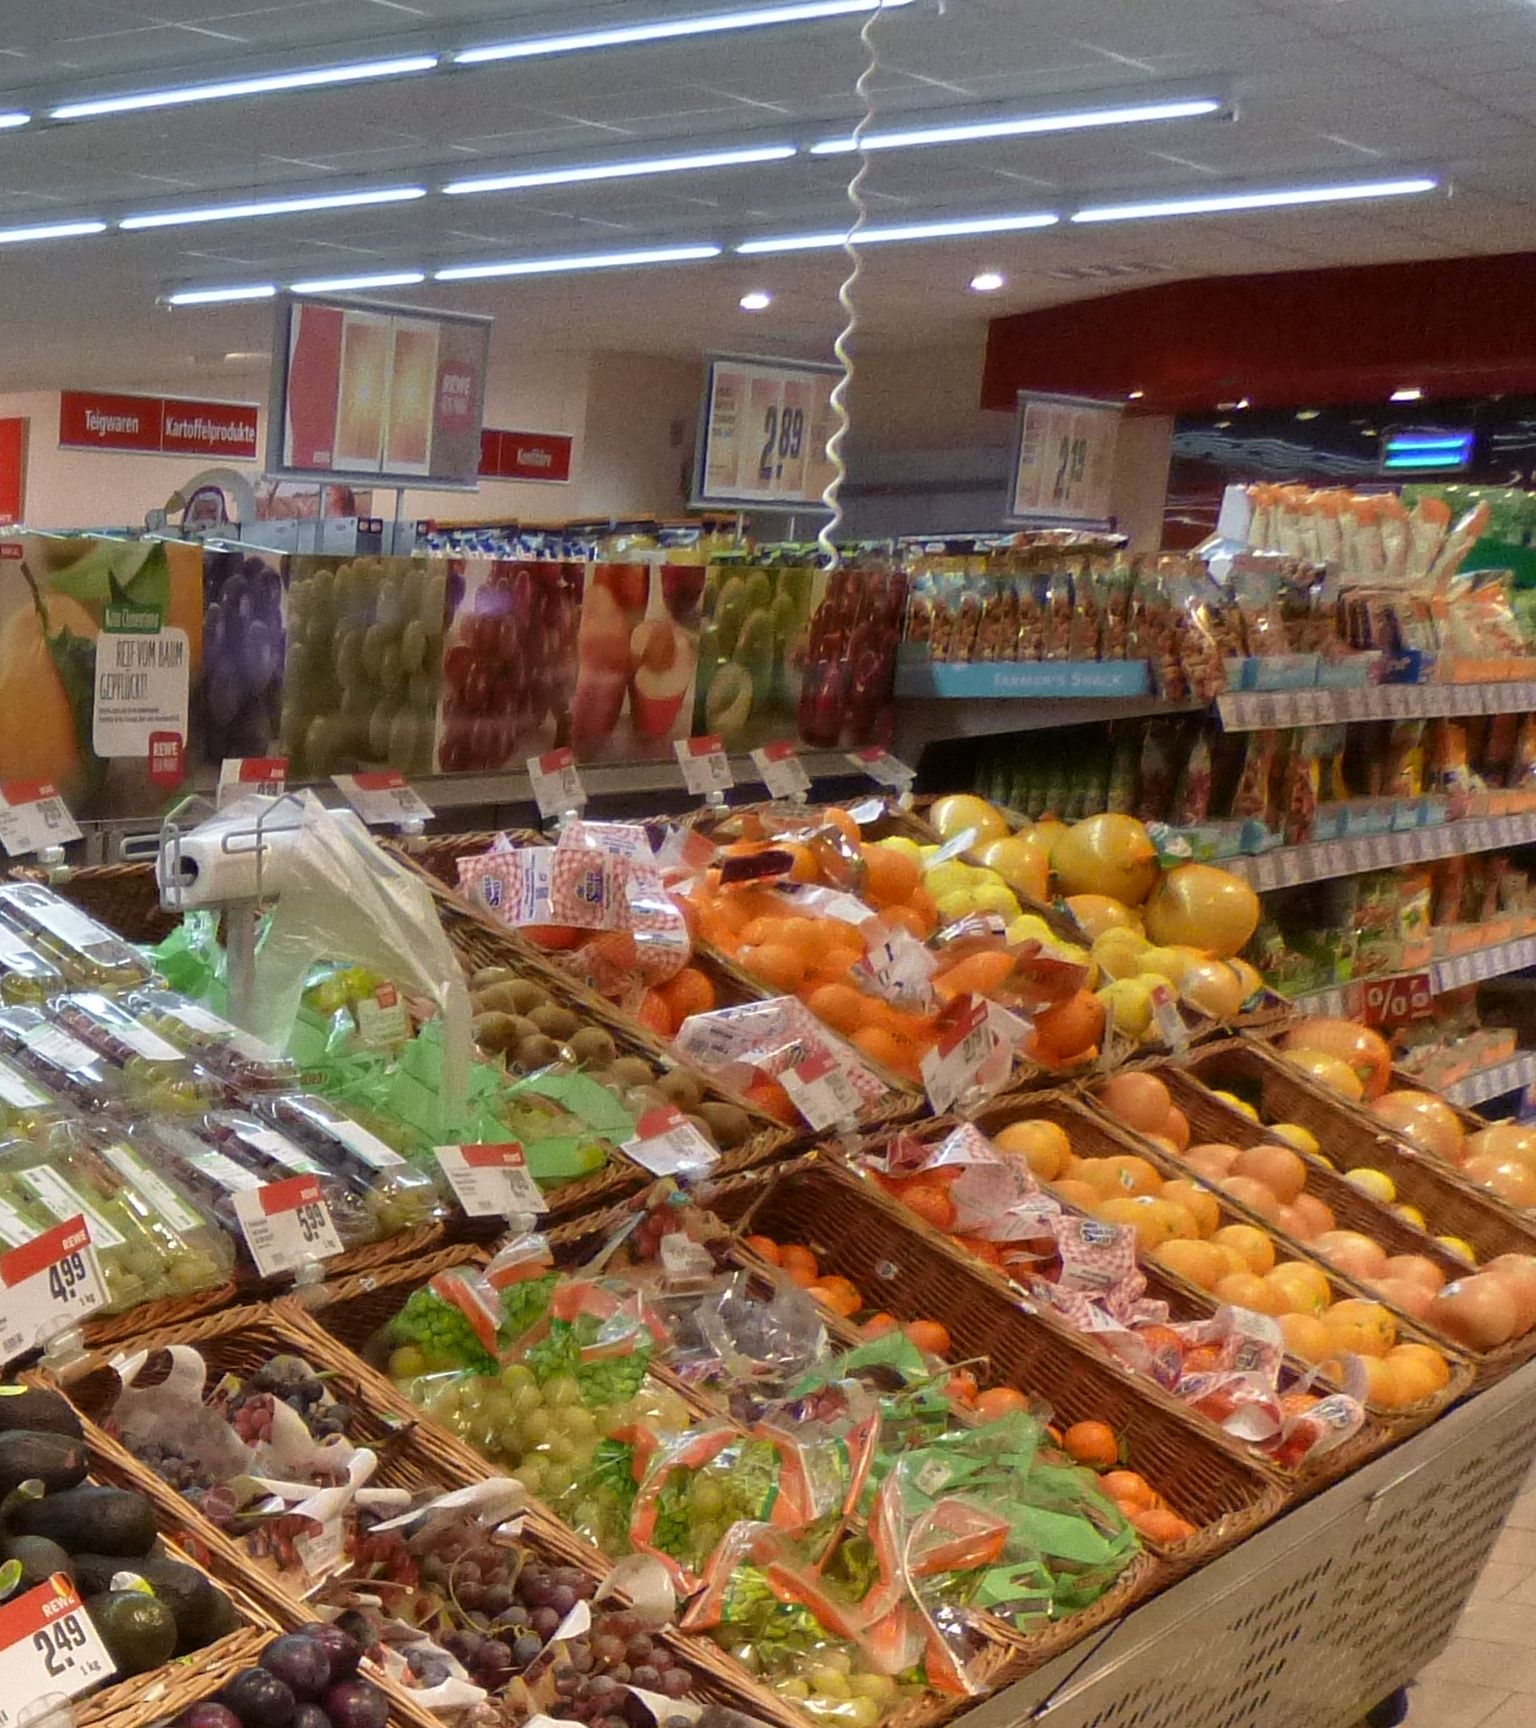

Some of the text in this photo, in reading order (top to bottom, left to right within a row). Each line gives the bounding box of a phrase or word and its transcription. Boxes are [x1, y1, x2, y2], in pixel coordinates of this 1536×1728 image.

[85, 410, 139, 437] Teigwaren
[165, 416, 256, 444] Kartoffelprodukte
[993, 672, 1124, 687] FARMER'S SNACK
[88, 1659, 102, 1674] kg
